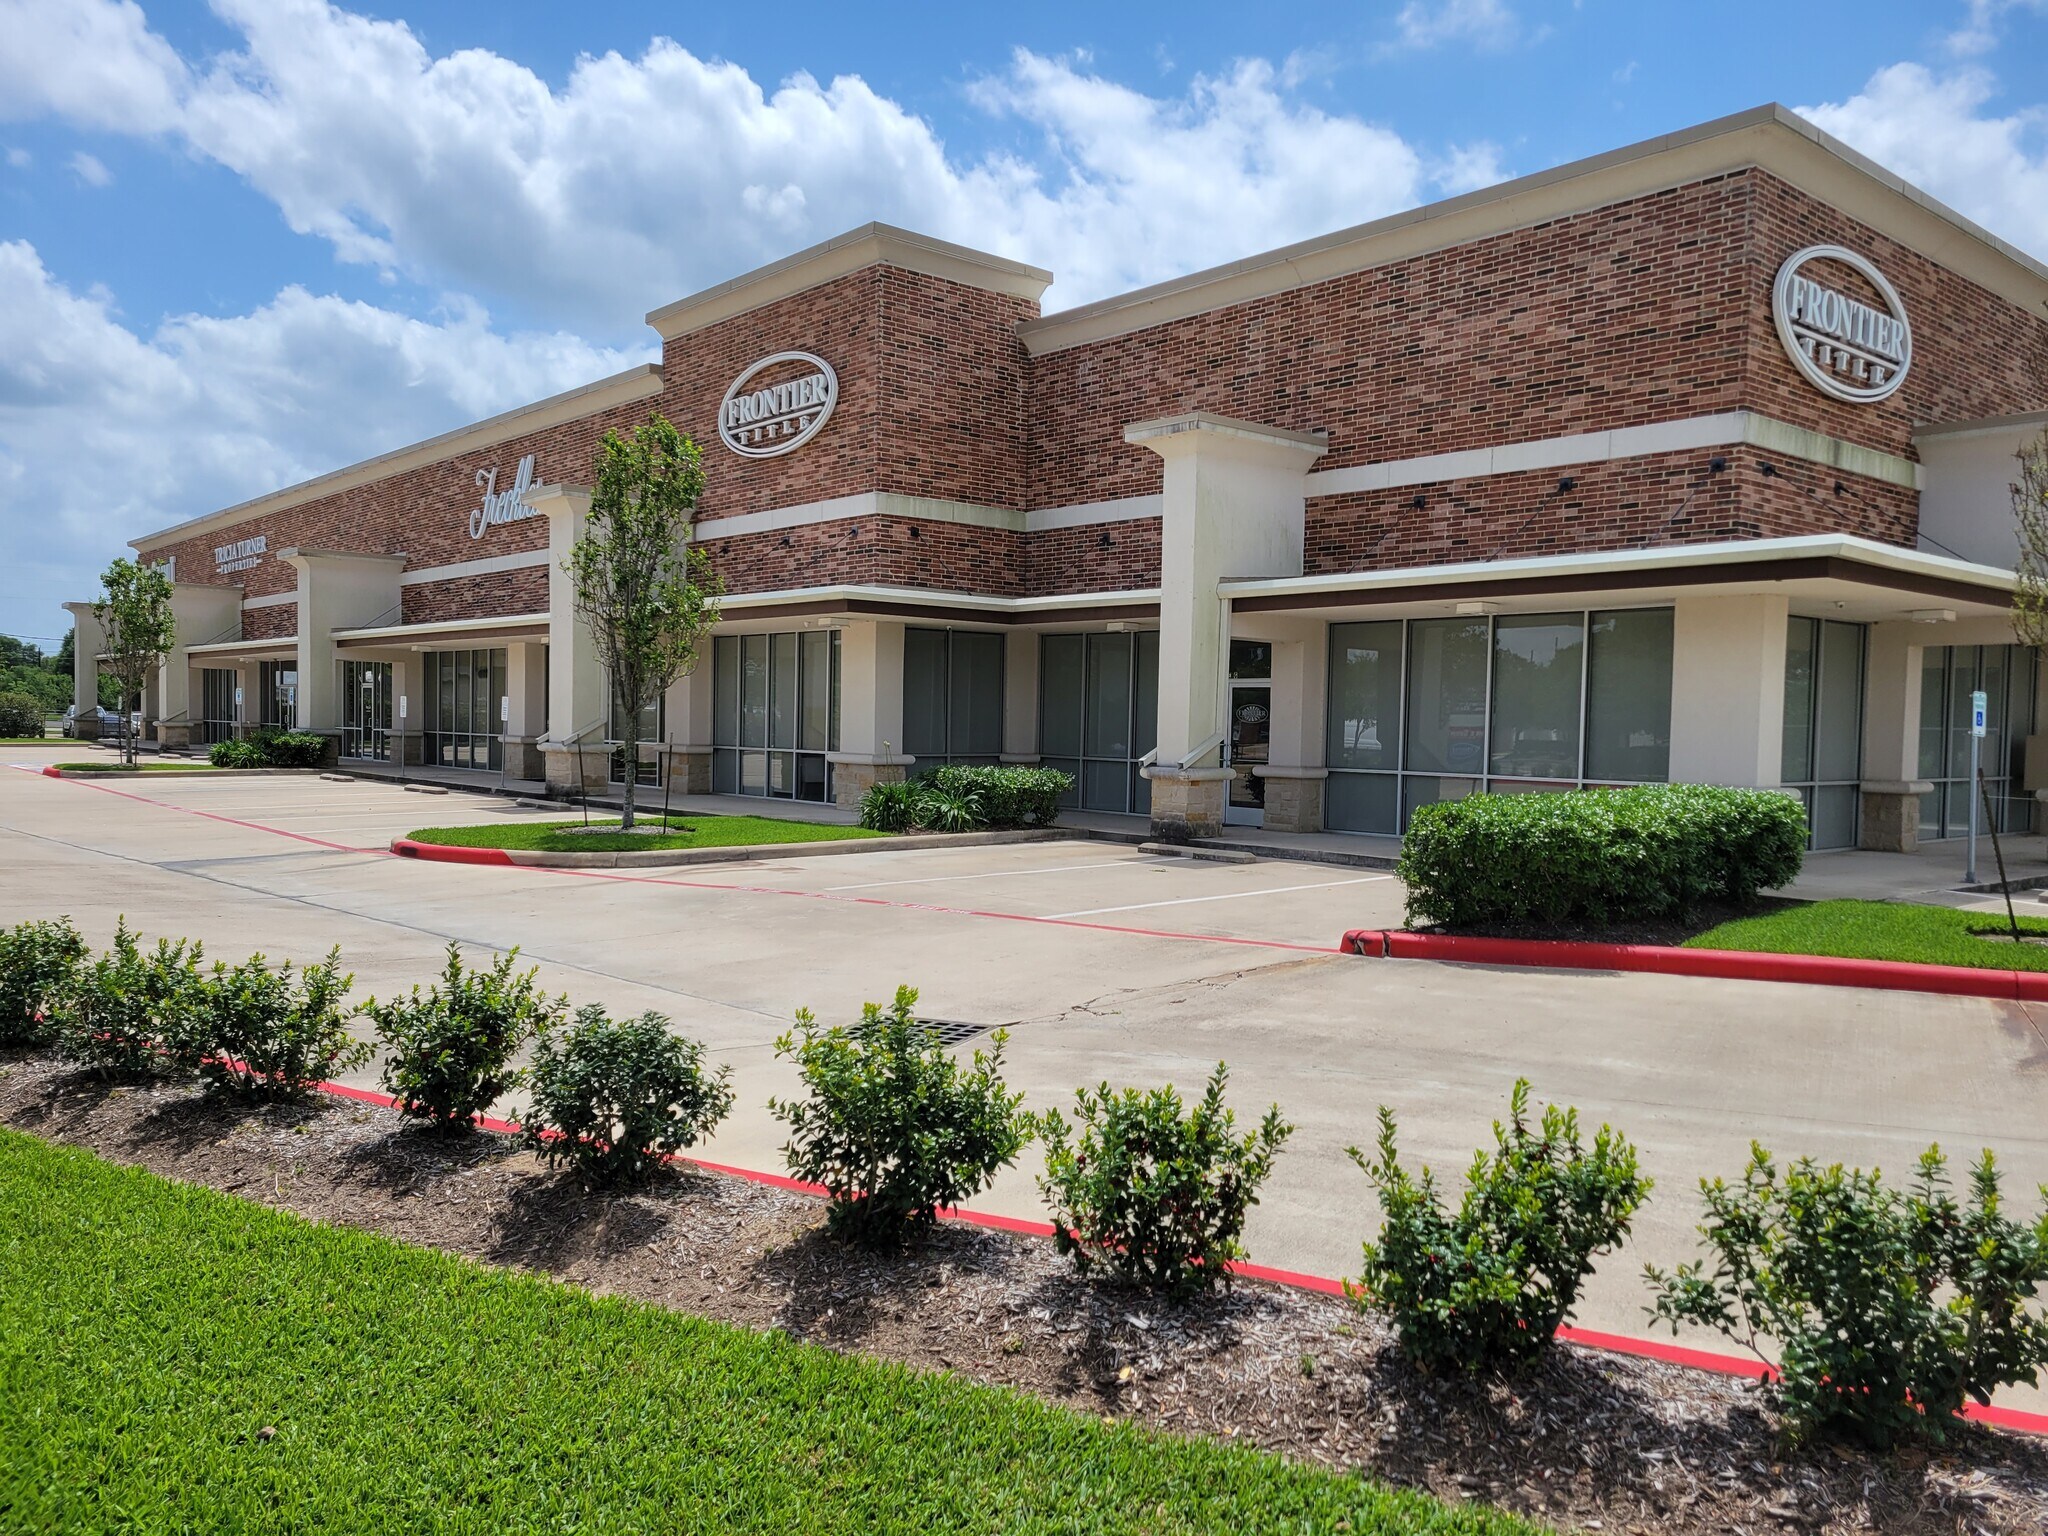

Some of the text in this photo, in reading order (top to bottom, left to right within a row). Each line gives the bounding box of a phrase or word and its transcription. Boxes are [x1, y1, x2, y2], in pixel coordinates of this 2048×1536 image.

[1789, 274, 1905, 362] FRONTIER
[1800, 337, 1886, 386] TITLE
[726, 373, 829, 428] FRONTIER
[739, 415, 811, 445] TITLE
[237, 536, 268, 557] TURNER
